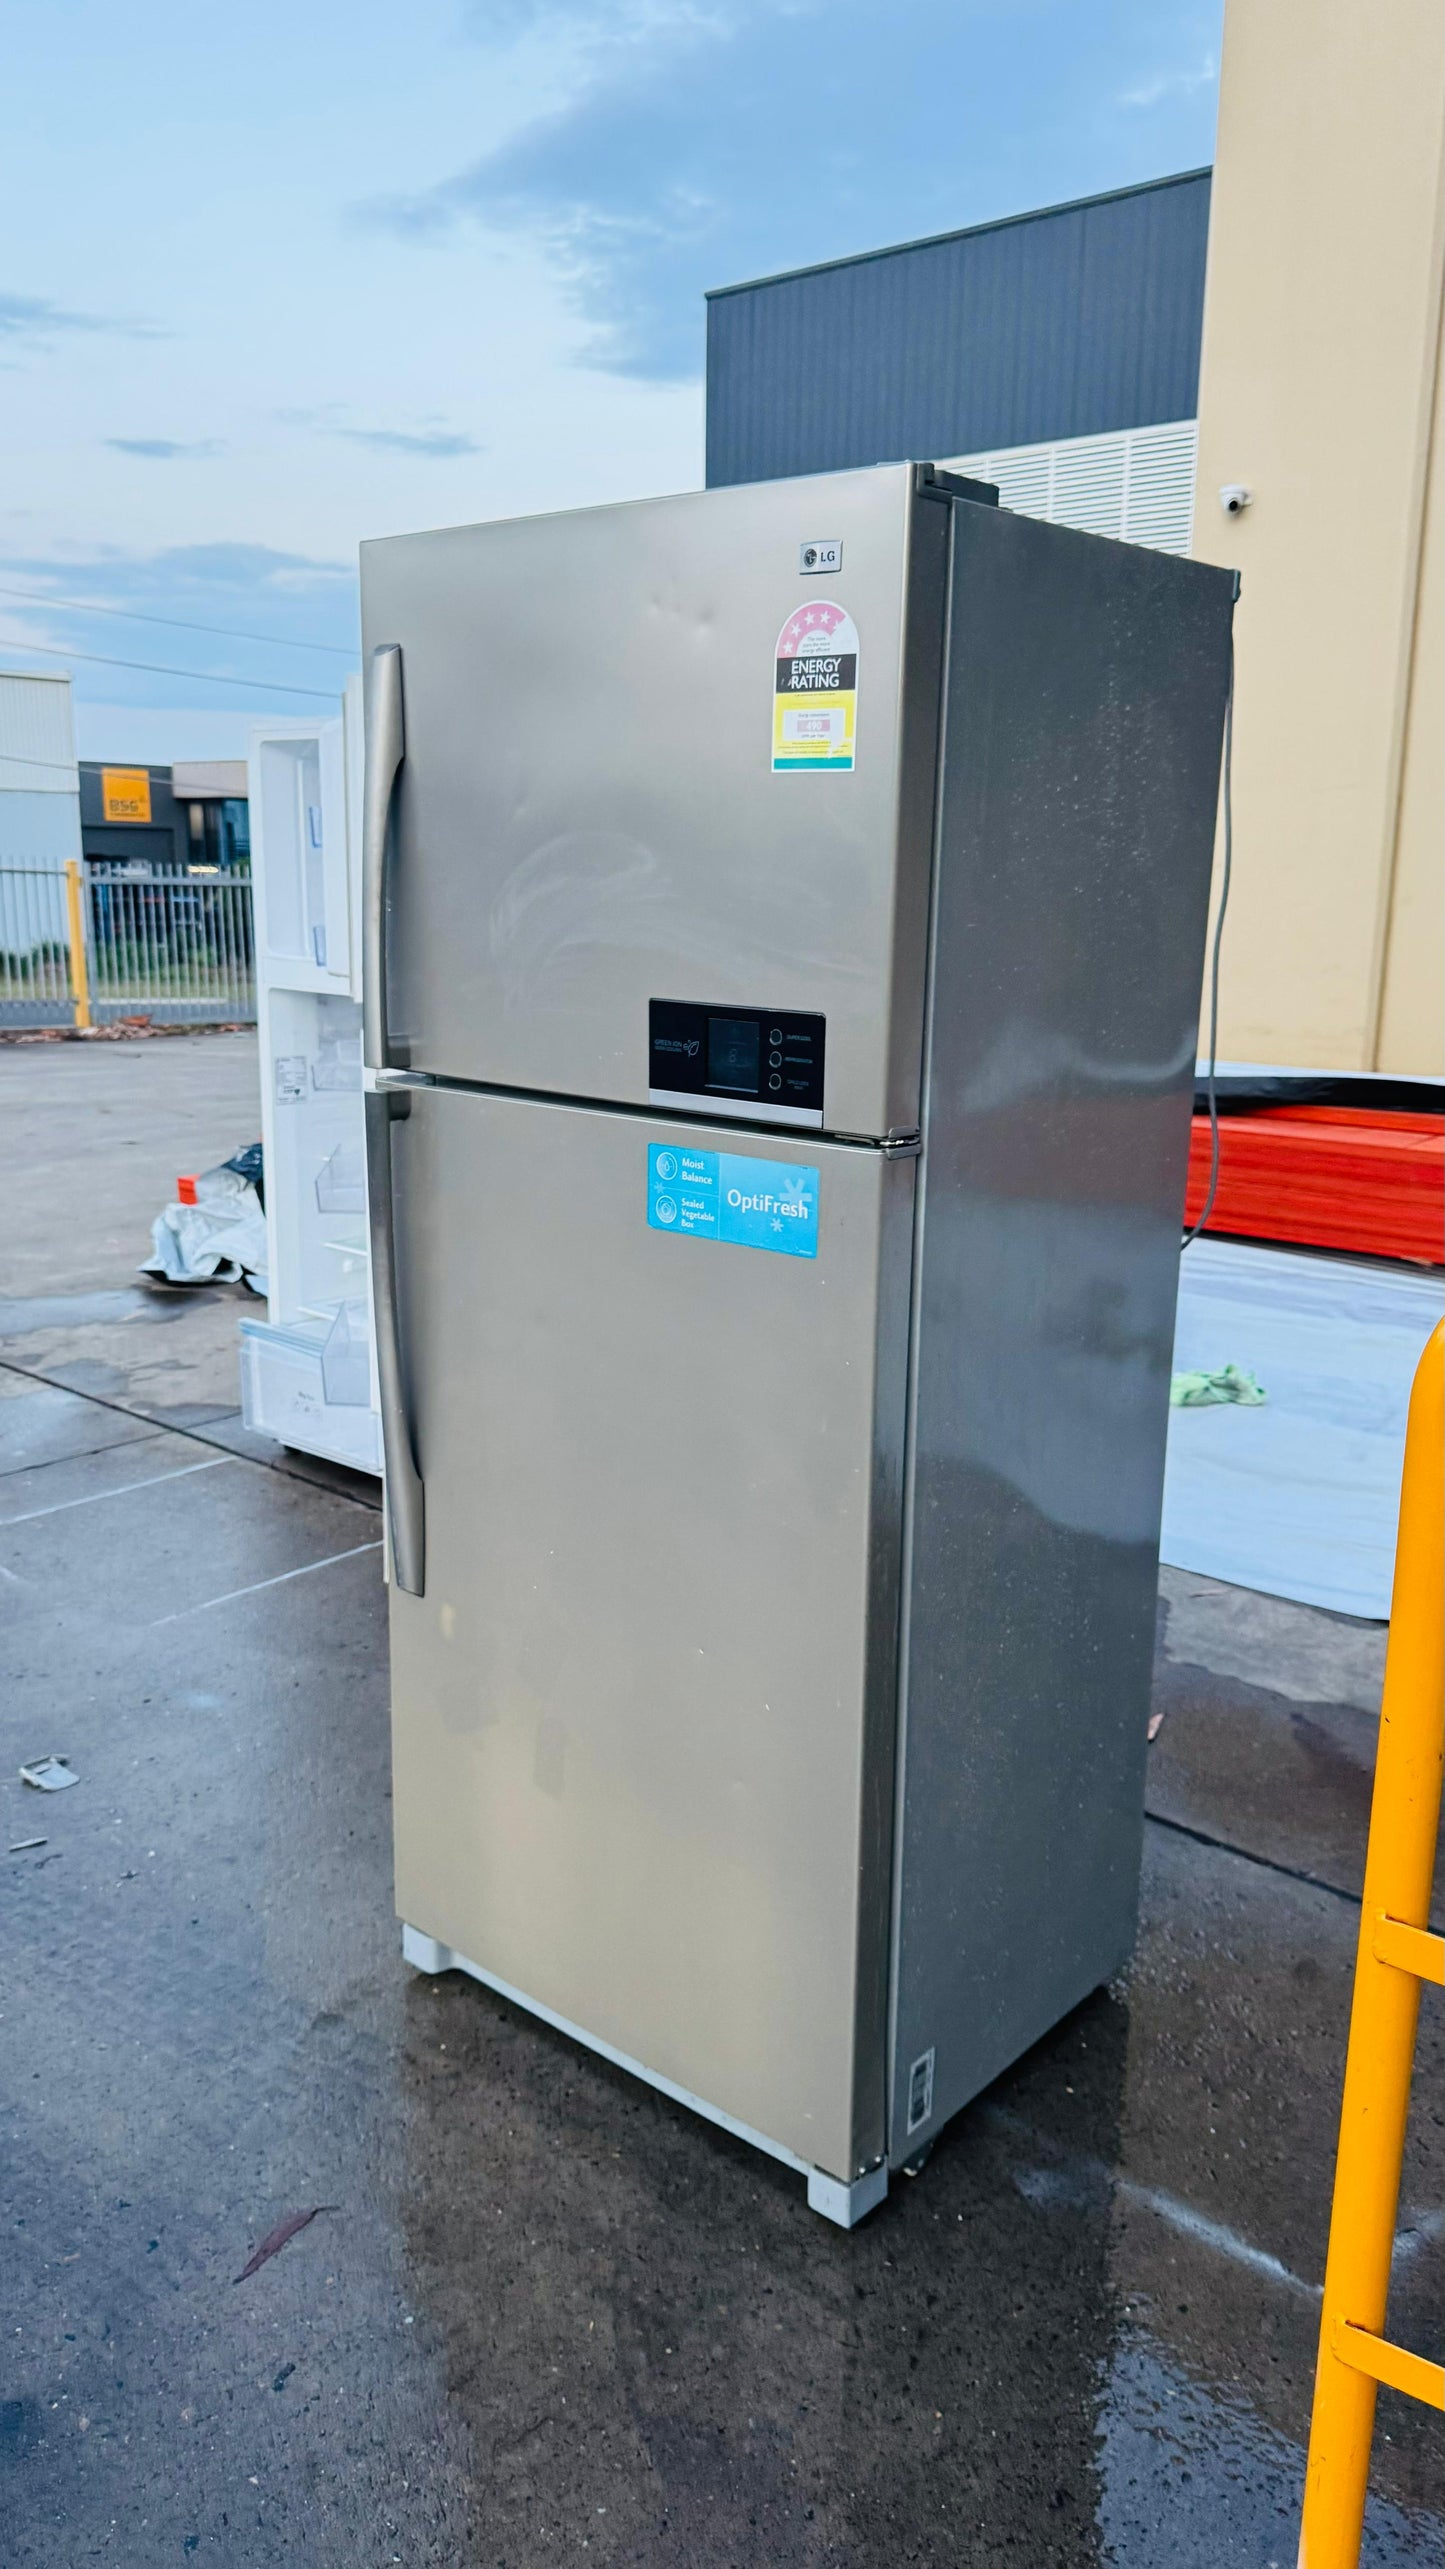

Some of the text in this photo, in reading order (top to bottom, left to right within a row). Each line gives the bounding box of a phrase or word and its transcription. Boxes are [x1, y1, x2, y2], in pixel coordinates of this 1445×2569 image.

[821, 551, 835, 562] LG
[791, 658, 841, 675] ENERGY
[791, 674, 840, 689] RATING
[681, 1157, 705, 1170] Moist
[681, 1171, 712, 1185] Balance
[681, 1197, 704, 1210] Sealed
[727, 1188, 808, 1220] OptiFresh
[681, 1208, 715, 1222] Vegetable
[681, 1218, 694, 1229] Box
